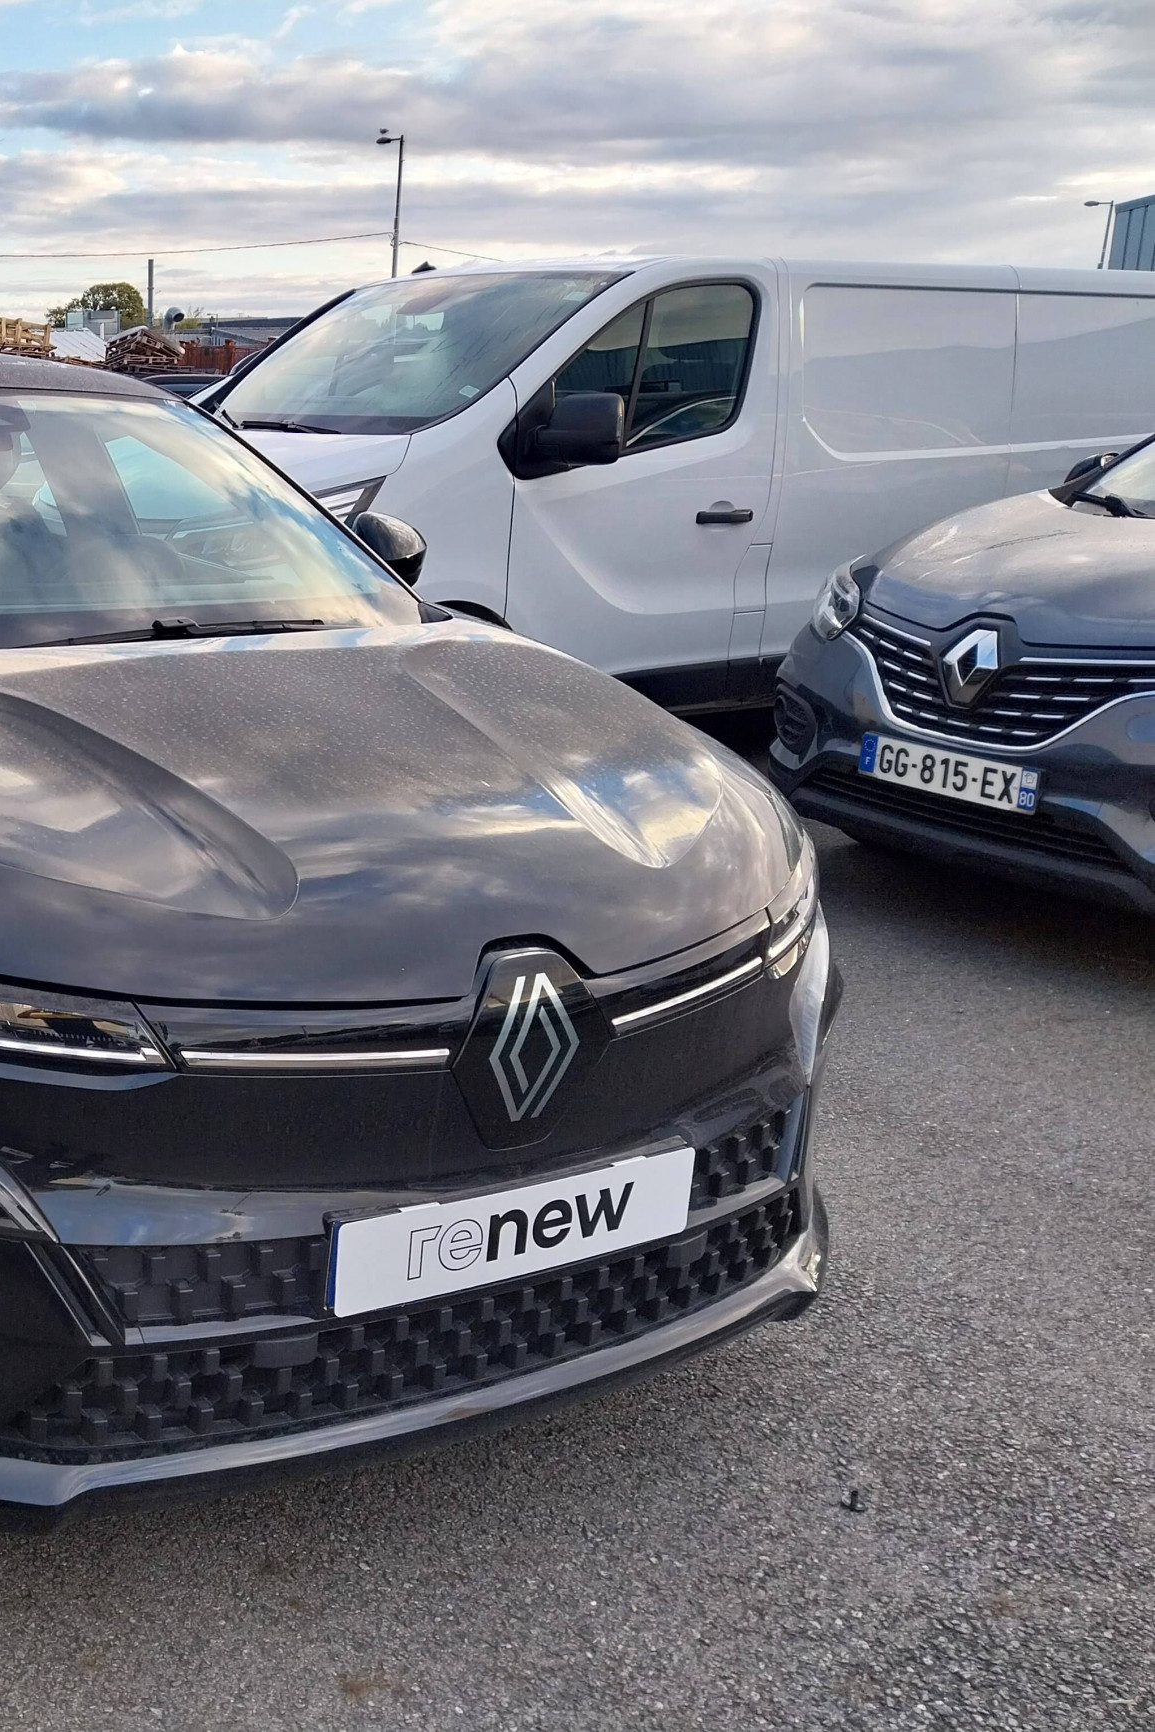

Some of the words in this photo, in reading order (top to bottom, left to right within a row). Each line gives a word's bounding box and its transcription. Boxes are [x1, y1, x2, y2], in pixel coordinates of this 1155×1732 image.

[864, 757, 871, 765] F
[879, 744, 1017, 804] GG-815-EX
[1018, 791, 1035, 808] 80
[407, 1181, 635, 1281] renew
